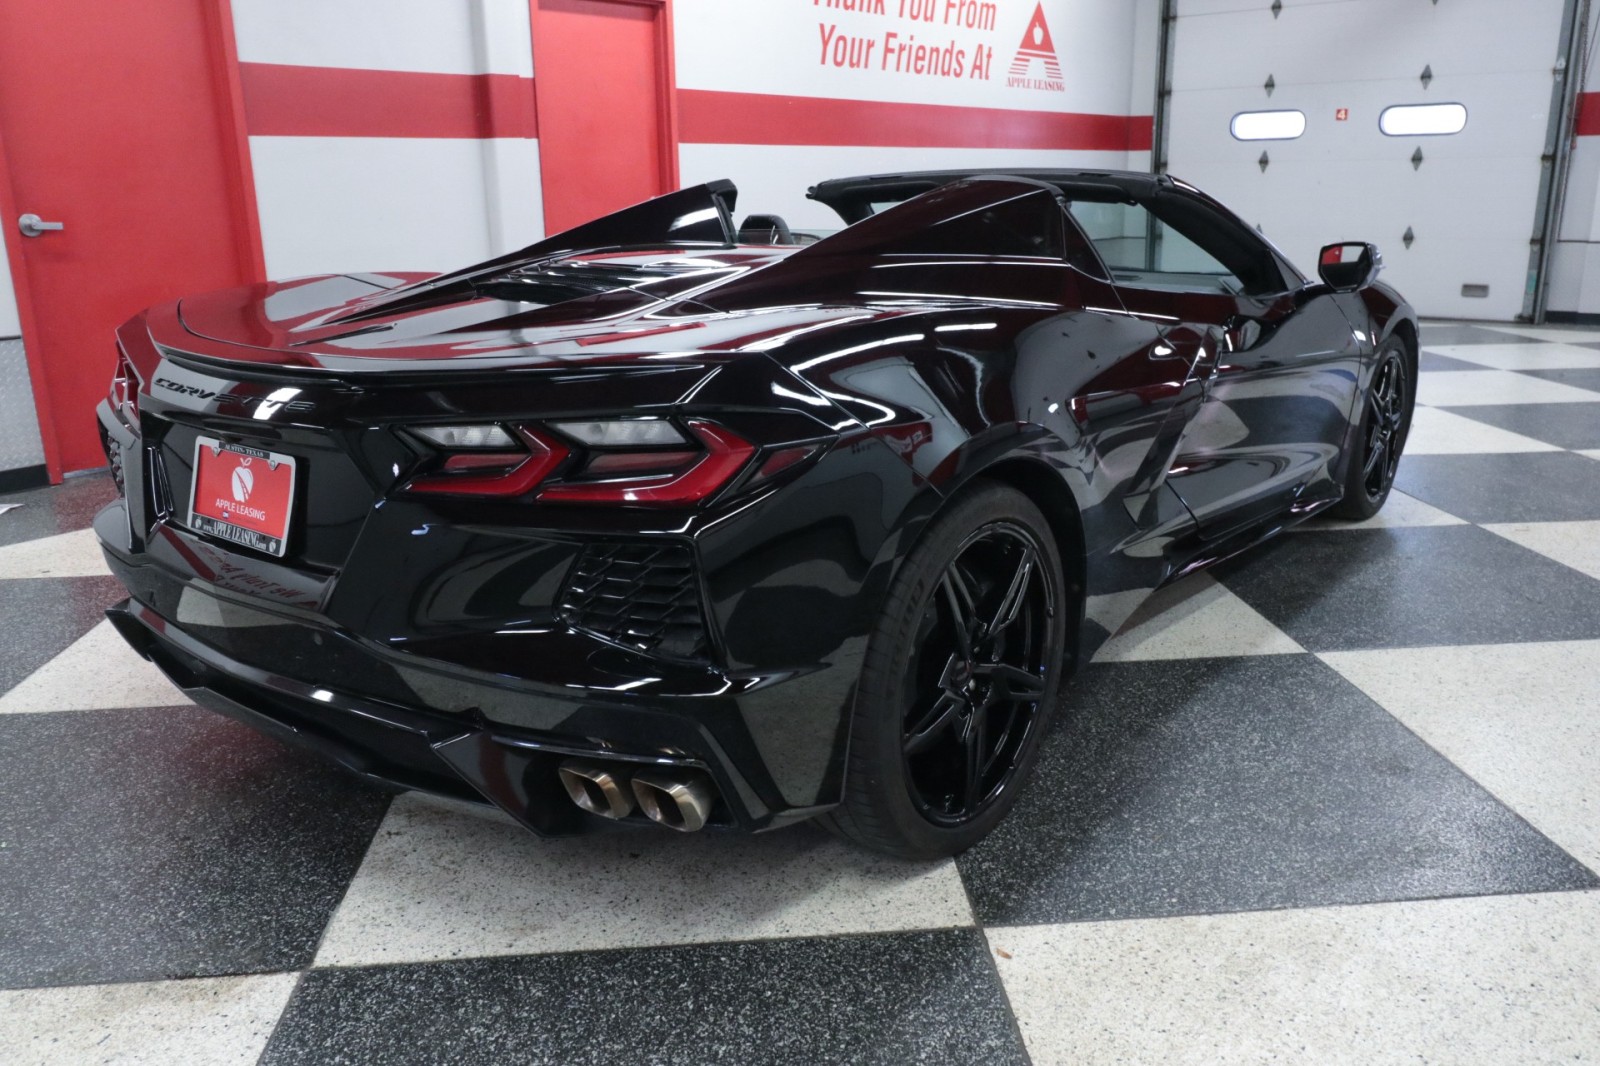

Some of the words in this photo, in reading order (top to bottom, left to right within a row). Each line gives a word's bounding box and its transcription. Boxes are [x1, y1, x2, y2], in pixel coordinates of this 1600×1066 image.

[818, 22, 876, 70] Your
[881, 31, 966, 79] Friends
[969, 43, 993, 81] At
[1005, 76, 1032, 89] APPLE
[1033, 79, 1065, 92] LEASING
[1336, 109, 1347, 120] 4
[215, 498, 236, 512] APPLE
[236, 504, 266, 521] LEASING
